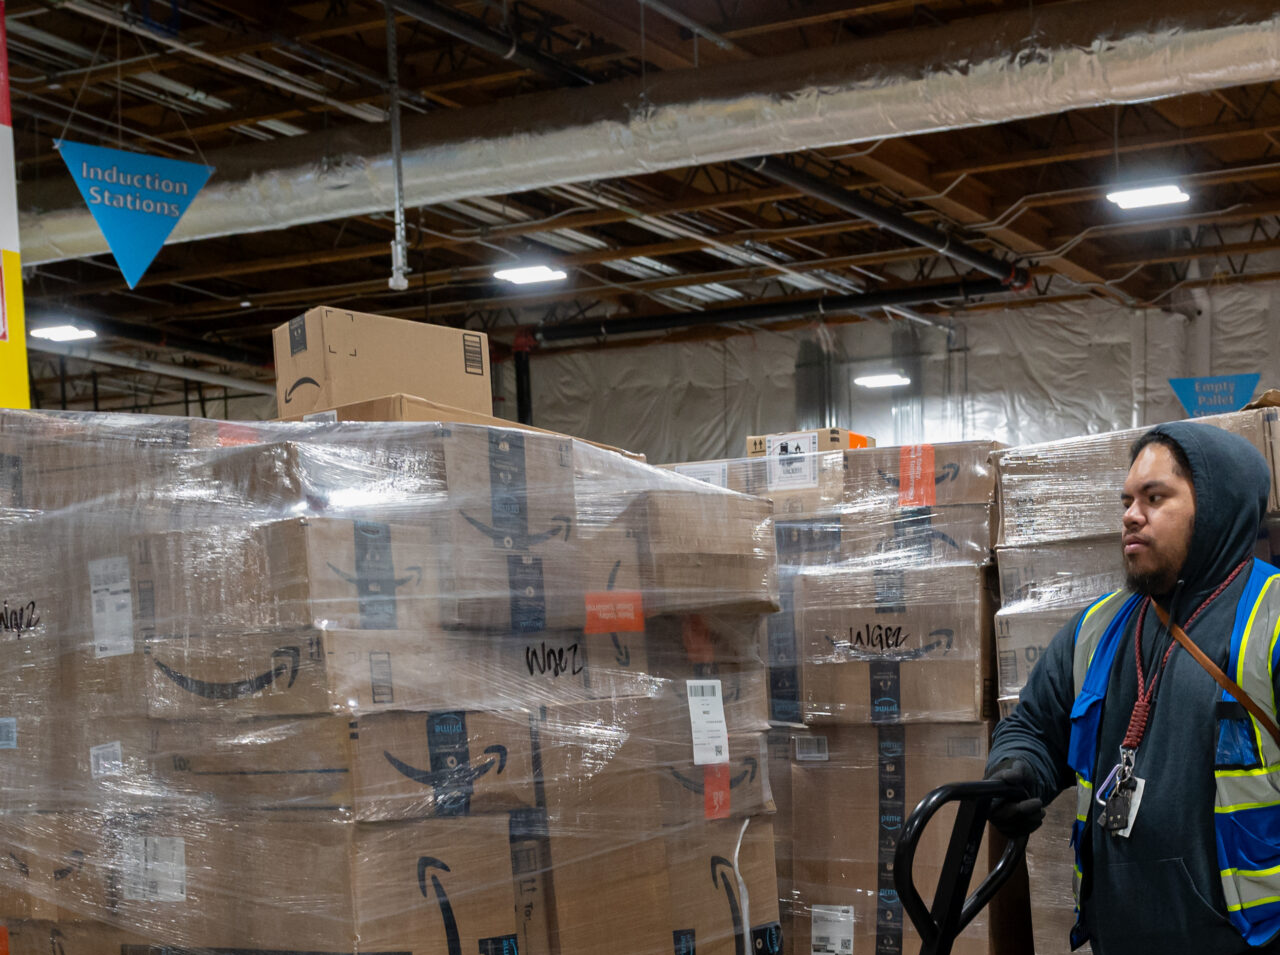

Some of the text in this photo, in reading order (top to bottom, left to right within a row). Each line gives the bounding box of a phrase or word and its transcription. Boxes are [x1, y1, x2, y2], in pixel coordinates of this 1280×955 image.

[81, 161, 188, 195] Induction
[89, 186, 181, 217] Stations
[1195, 381, 1236, 393] Empty
[1198, 394, 1235, 406] Pallet
[874, 704, 898, 713] prime
[434, 721, 463, 735] prime
